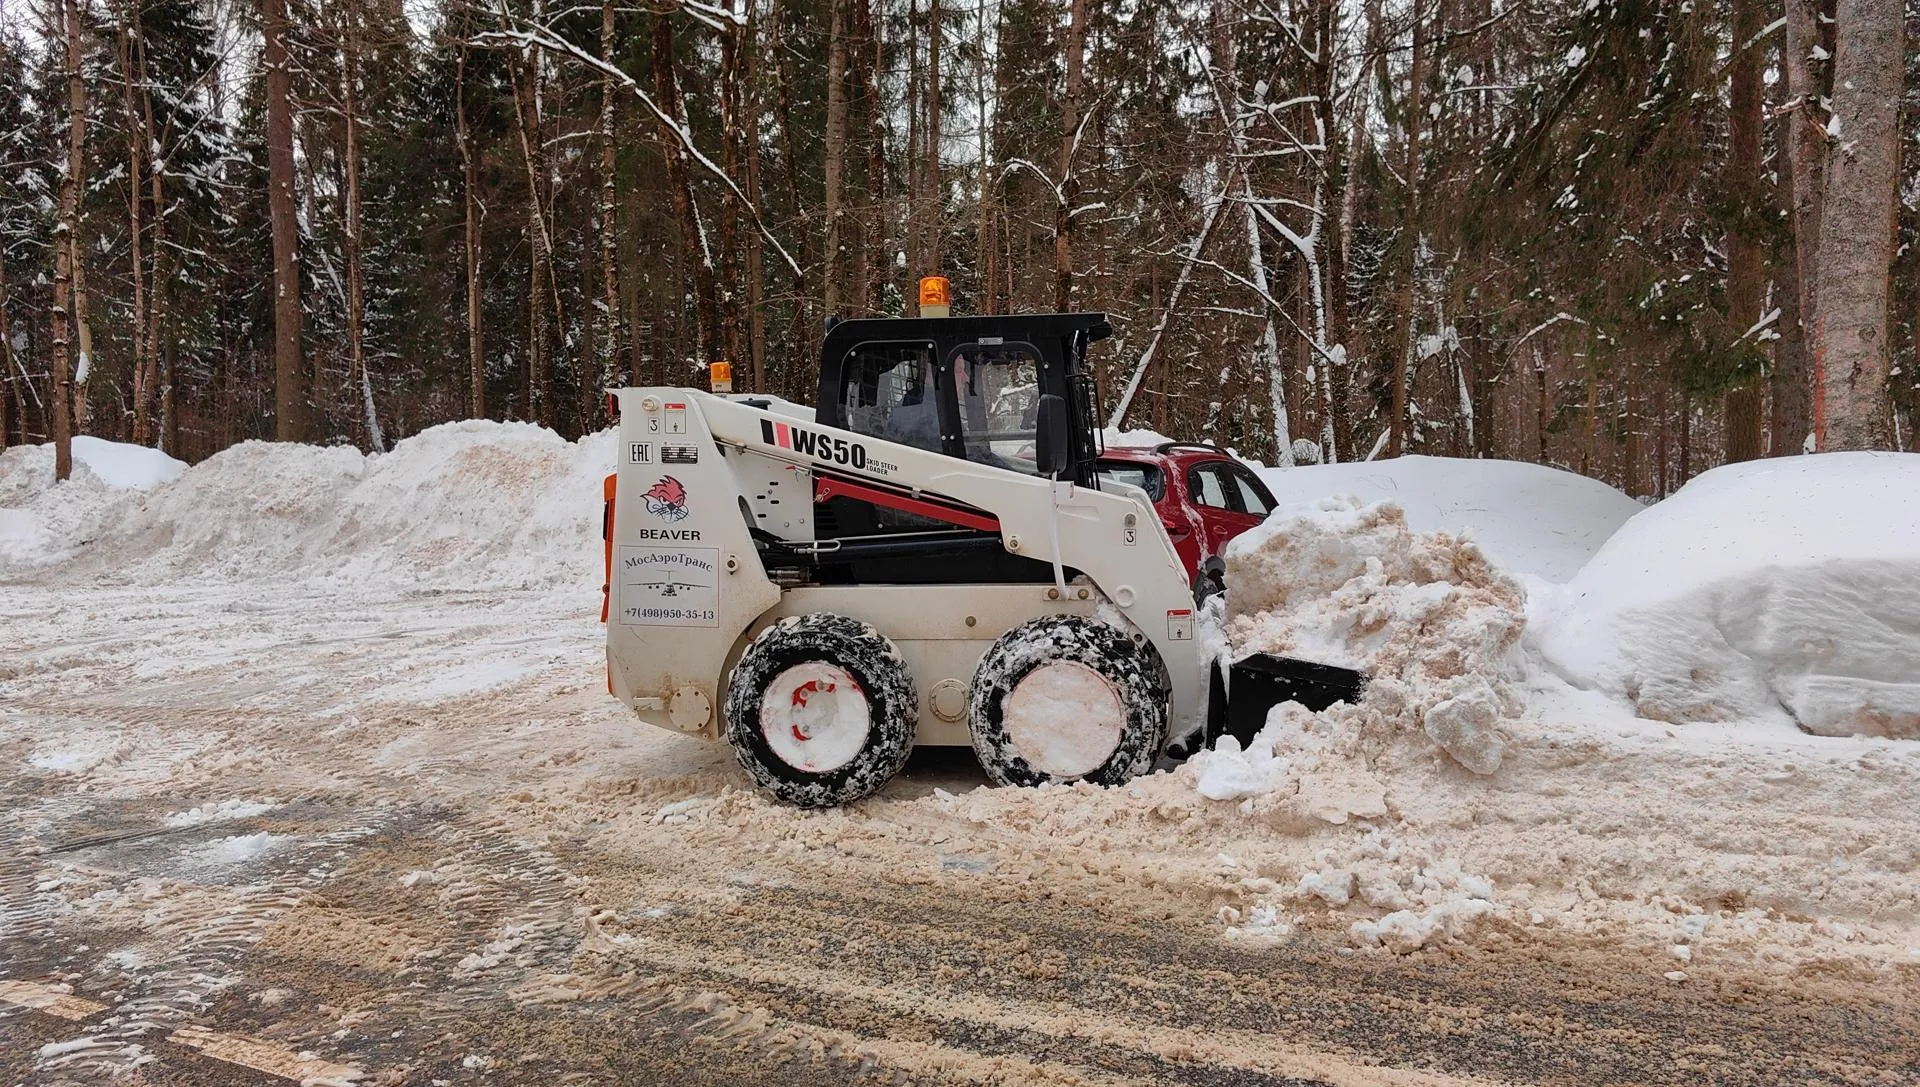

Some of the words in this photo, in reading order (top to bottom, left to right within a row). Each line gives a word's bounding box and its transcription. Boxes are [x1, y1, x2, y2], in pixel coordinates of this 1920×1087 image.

[631, 444, 650, 462] EAC
[791, 426, 866, 469] WS50
[866, 458, 880, 467] SKID
[881, 461, 898, 471] STEER
[866, 465, 888, 475] LOADER
[640, 529, 701, 541] BEAVER
[625, 553, 713, 572] МосАэроТранс
[625, 607, 714, 620] +7(498)950-35-13
